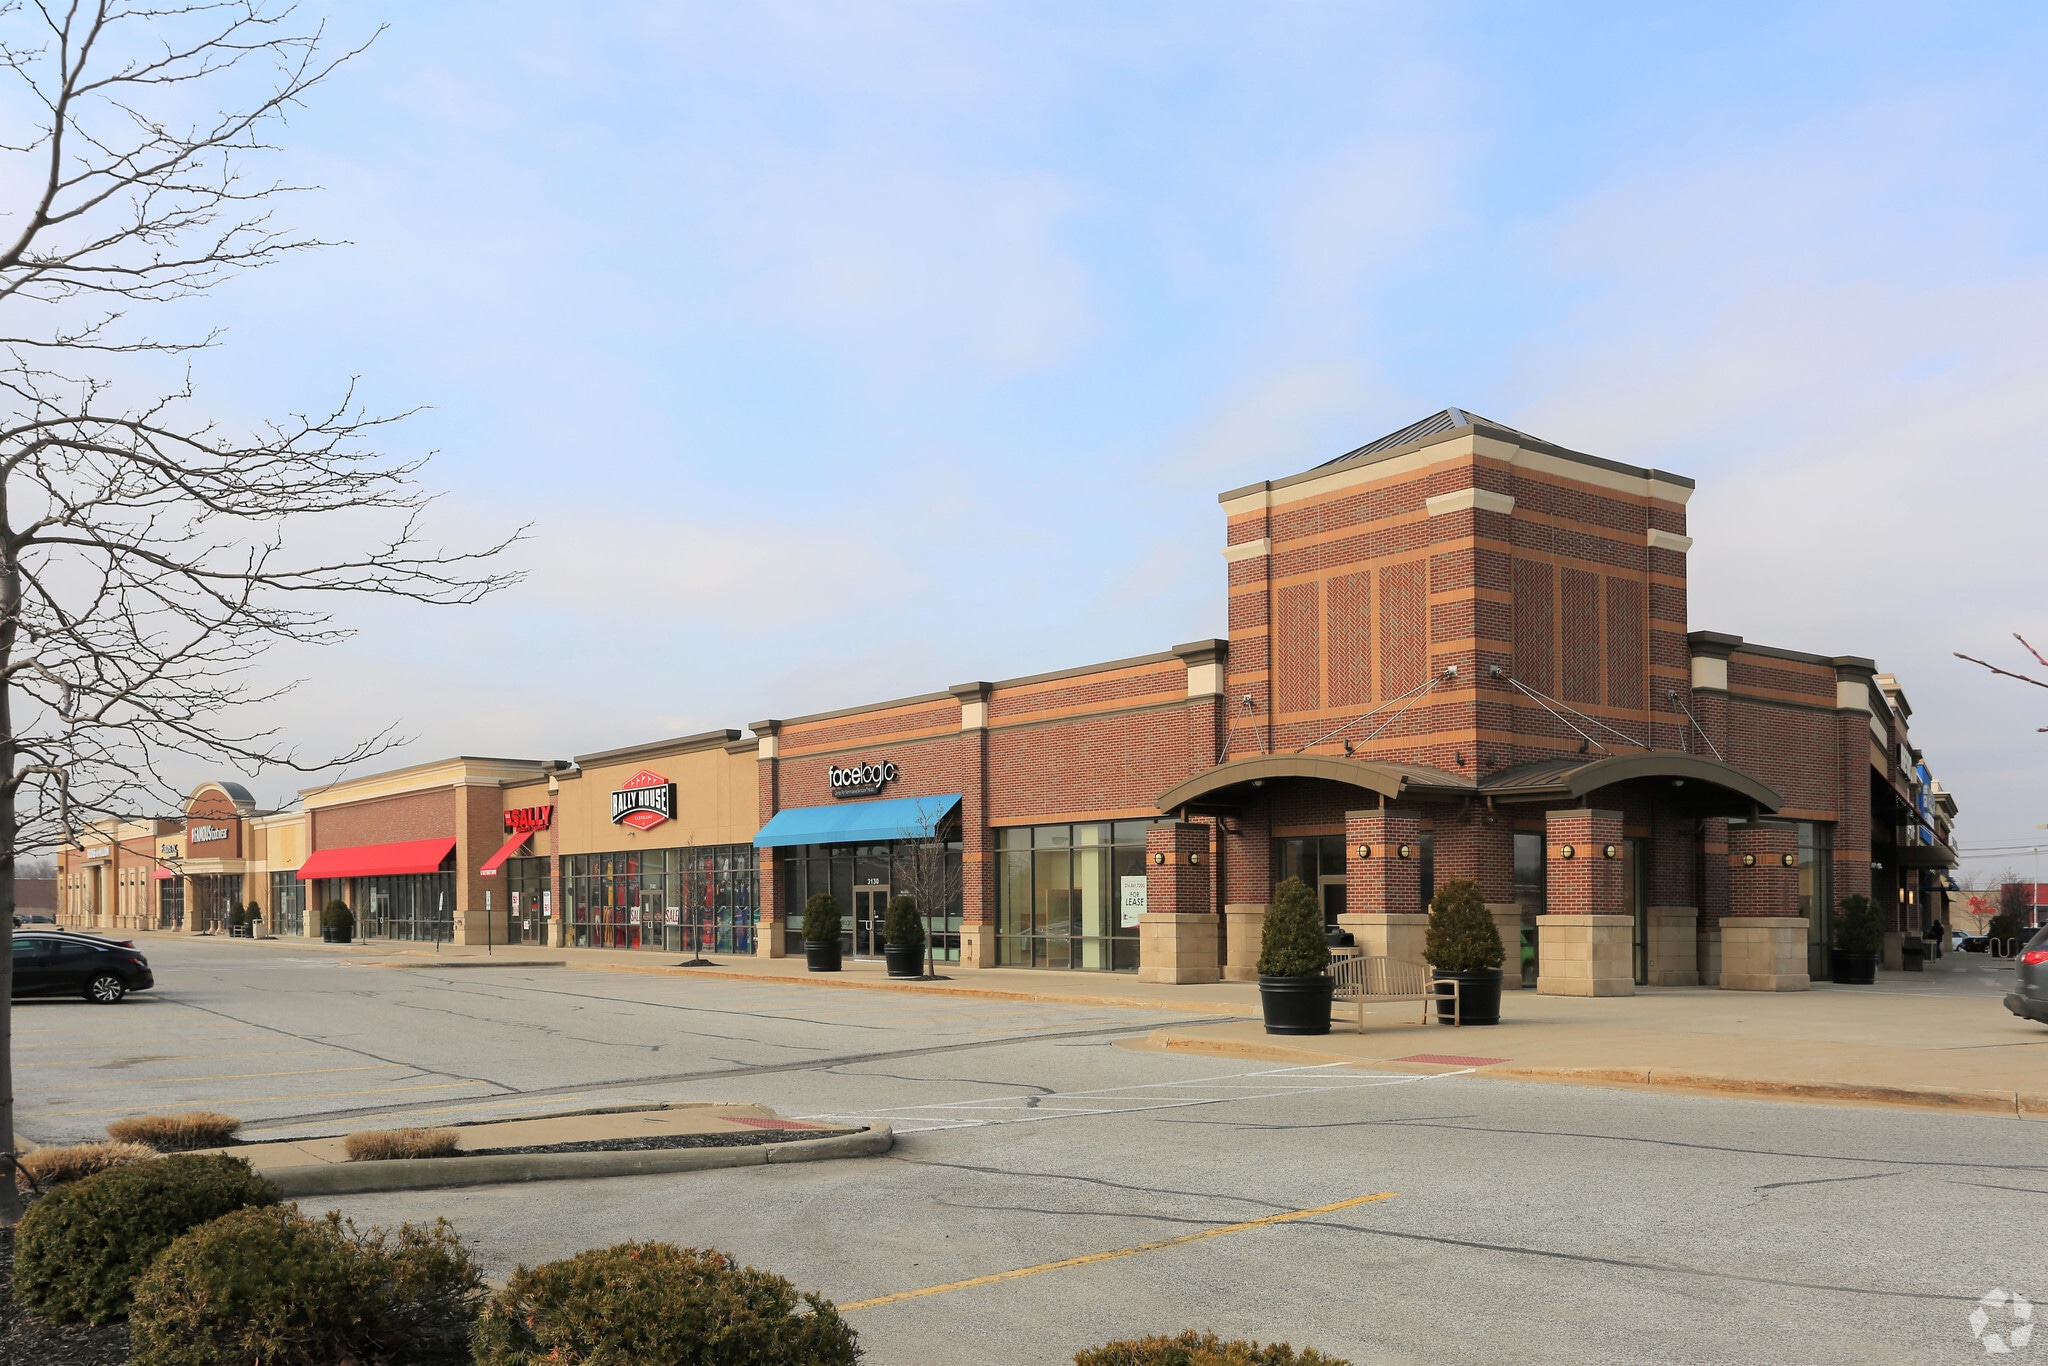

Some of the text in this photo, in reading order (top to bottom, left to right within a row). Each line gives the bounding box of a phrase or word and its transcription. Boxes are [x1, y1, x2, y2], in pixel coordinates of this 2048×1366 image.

[828, 760, 894, 788] facelogic
[612, 788, 667, 817] RALLY HOUSE
[511, 805, 551, 828] SALLY
[1125, 898, 1144, 906] LEASE
[630, 909, 640, 921] SAL
[665, 909, 679, 922] SALE
